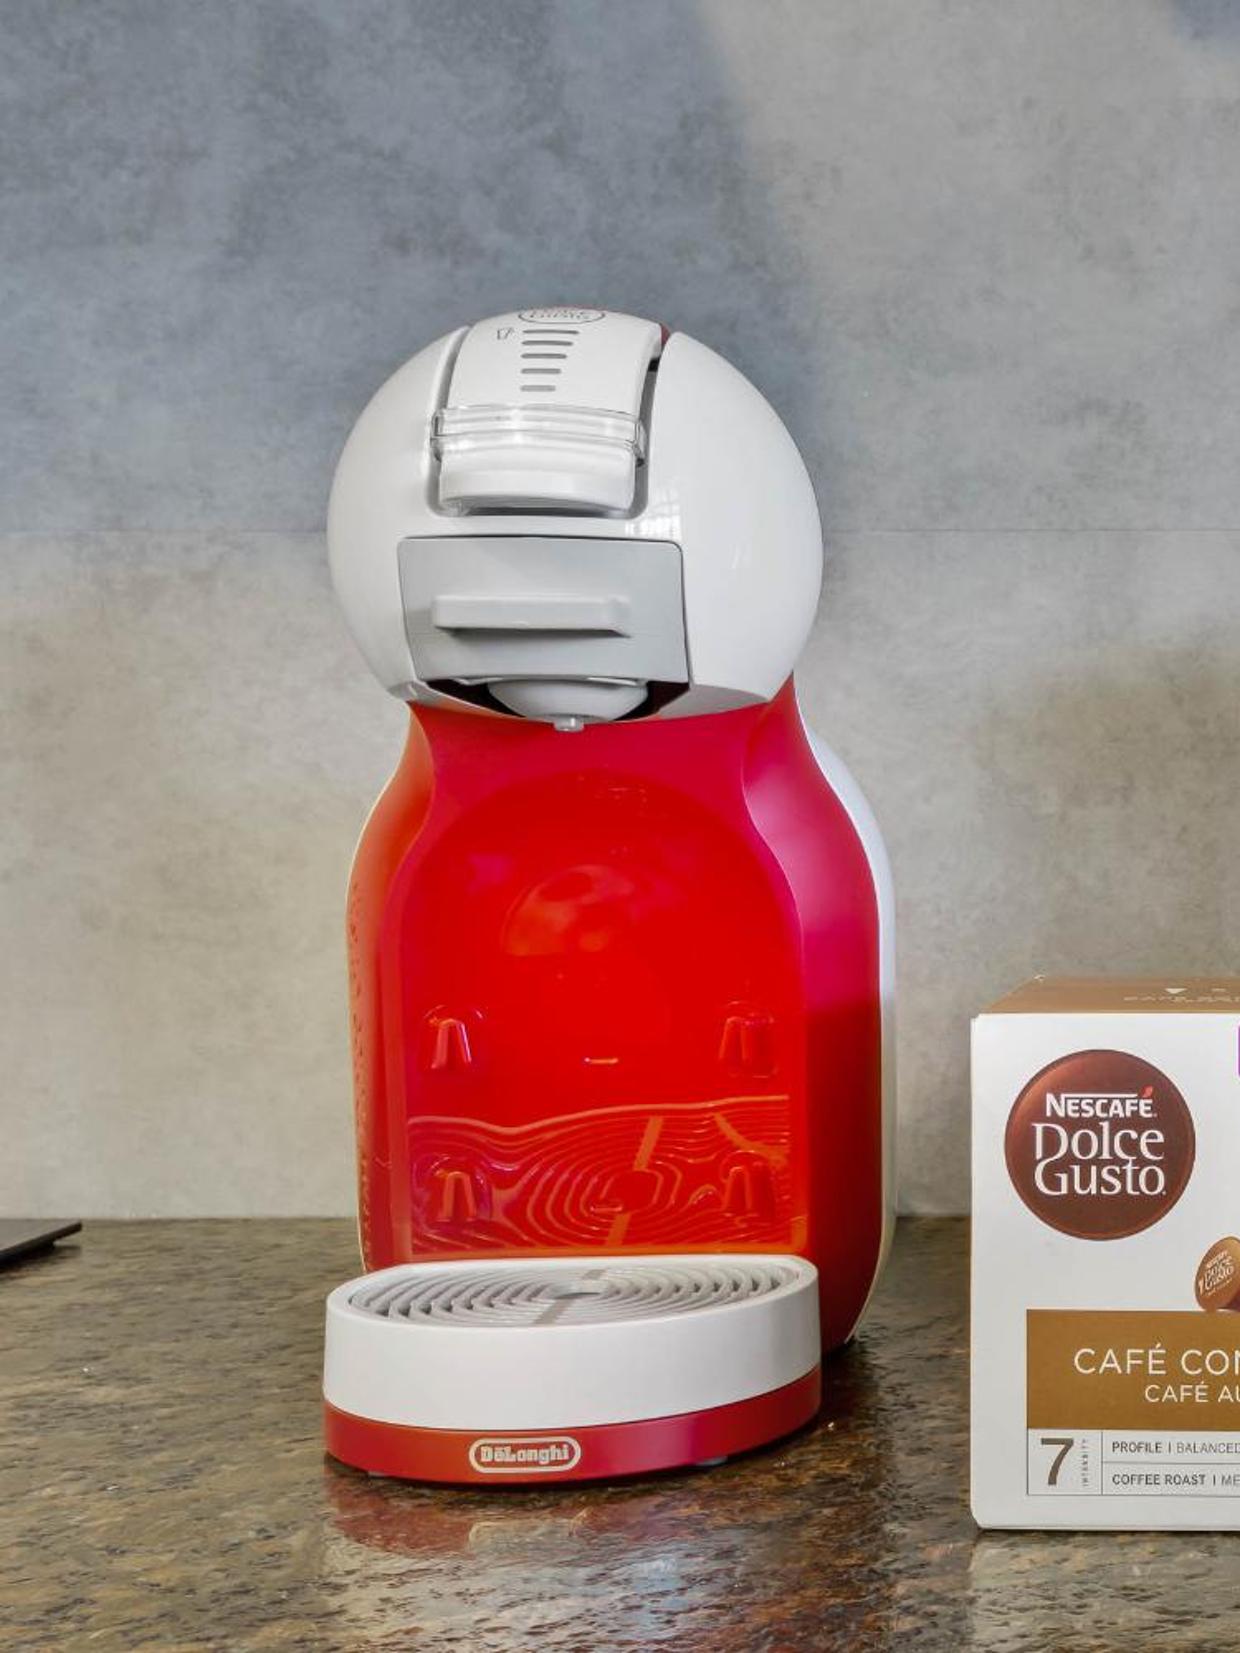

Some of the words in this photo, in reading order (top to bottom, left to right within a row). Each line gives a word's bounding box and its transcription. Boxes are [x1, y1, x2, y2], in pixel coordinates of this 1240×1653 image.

[1046, 1086, 1154, 1118] NESCAFÉ
[1032, 1121, 1165, 1160] Dolce
[1034, 1158, 1166, 1196] Gusto
[1073, 1343, 1167, 1375] CAFÉ
[1144, 1381, 1208, 1403] CAFÉ
[1040, 1437, 1075, 1487] 7
[1112, 1442, 1163, 1454] PROFILE
[1112, 1473, 1161, 1486] COFFEE
[1165, 1473, 1206, 1486] ROAST
